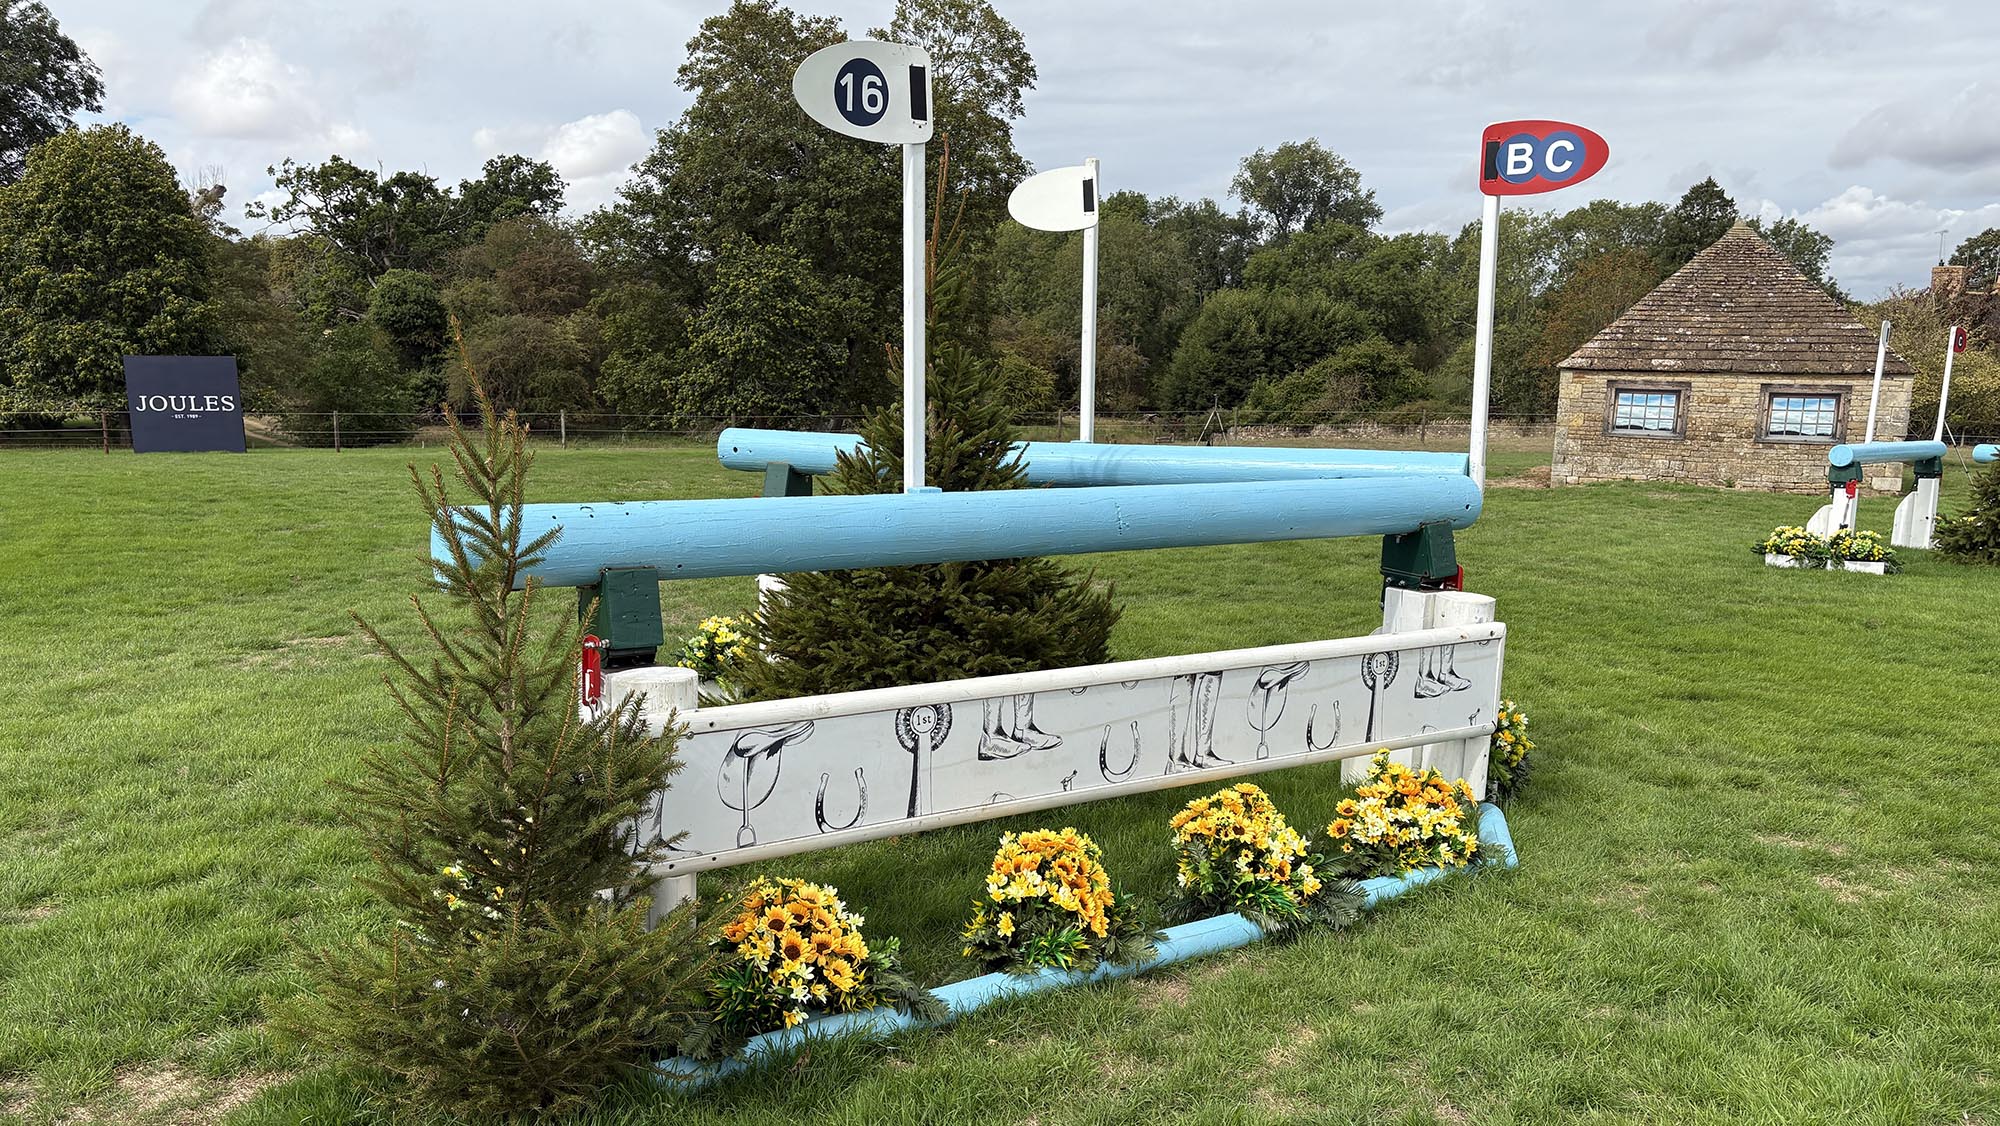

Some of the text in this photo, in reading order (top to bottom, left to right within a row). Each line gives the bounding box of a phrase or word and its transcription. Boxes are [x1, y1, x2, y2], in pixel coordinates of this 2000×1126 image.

[839, 72, 884, 114] 16
[135, 395, 235, 412] JOULES
[1375, 659, 1386, 669] 1st
[916, 714, 932, 726] 1st
